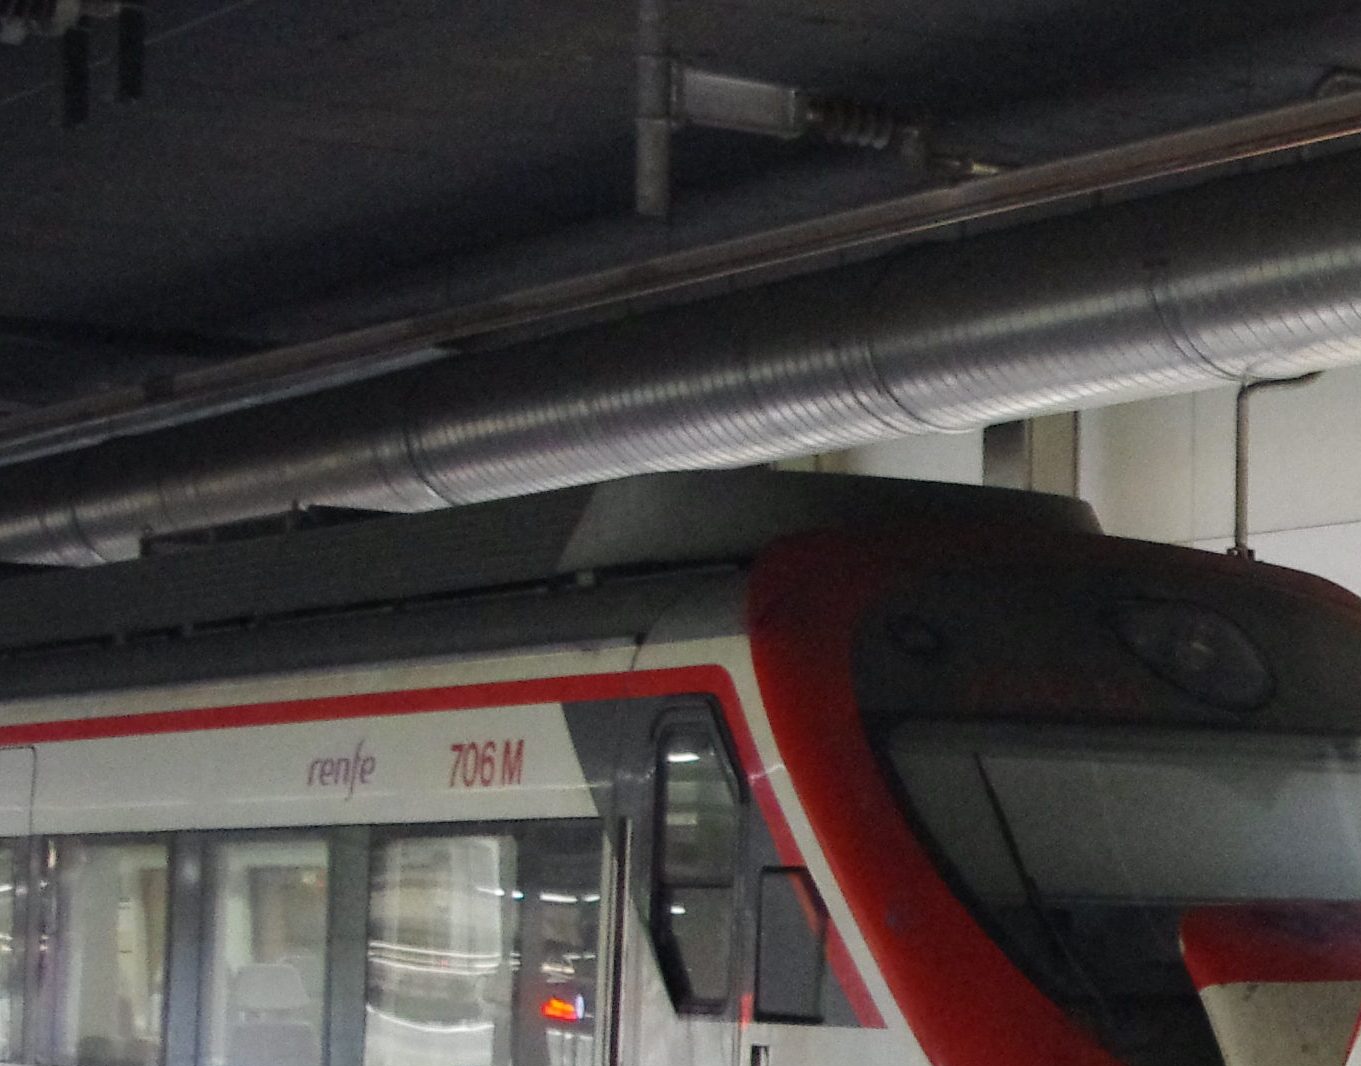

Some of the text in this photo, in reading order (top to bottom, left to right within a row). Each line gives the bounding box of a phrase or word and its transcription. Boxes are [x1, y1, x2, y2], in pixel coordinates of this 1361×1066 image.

[307, 739, 376, 801] renfe
[449, 739, 525, 787] 706 M
